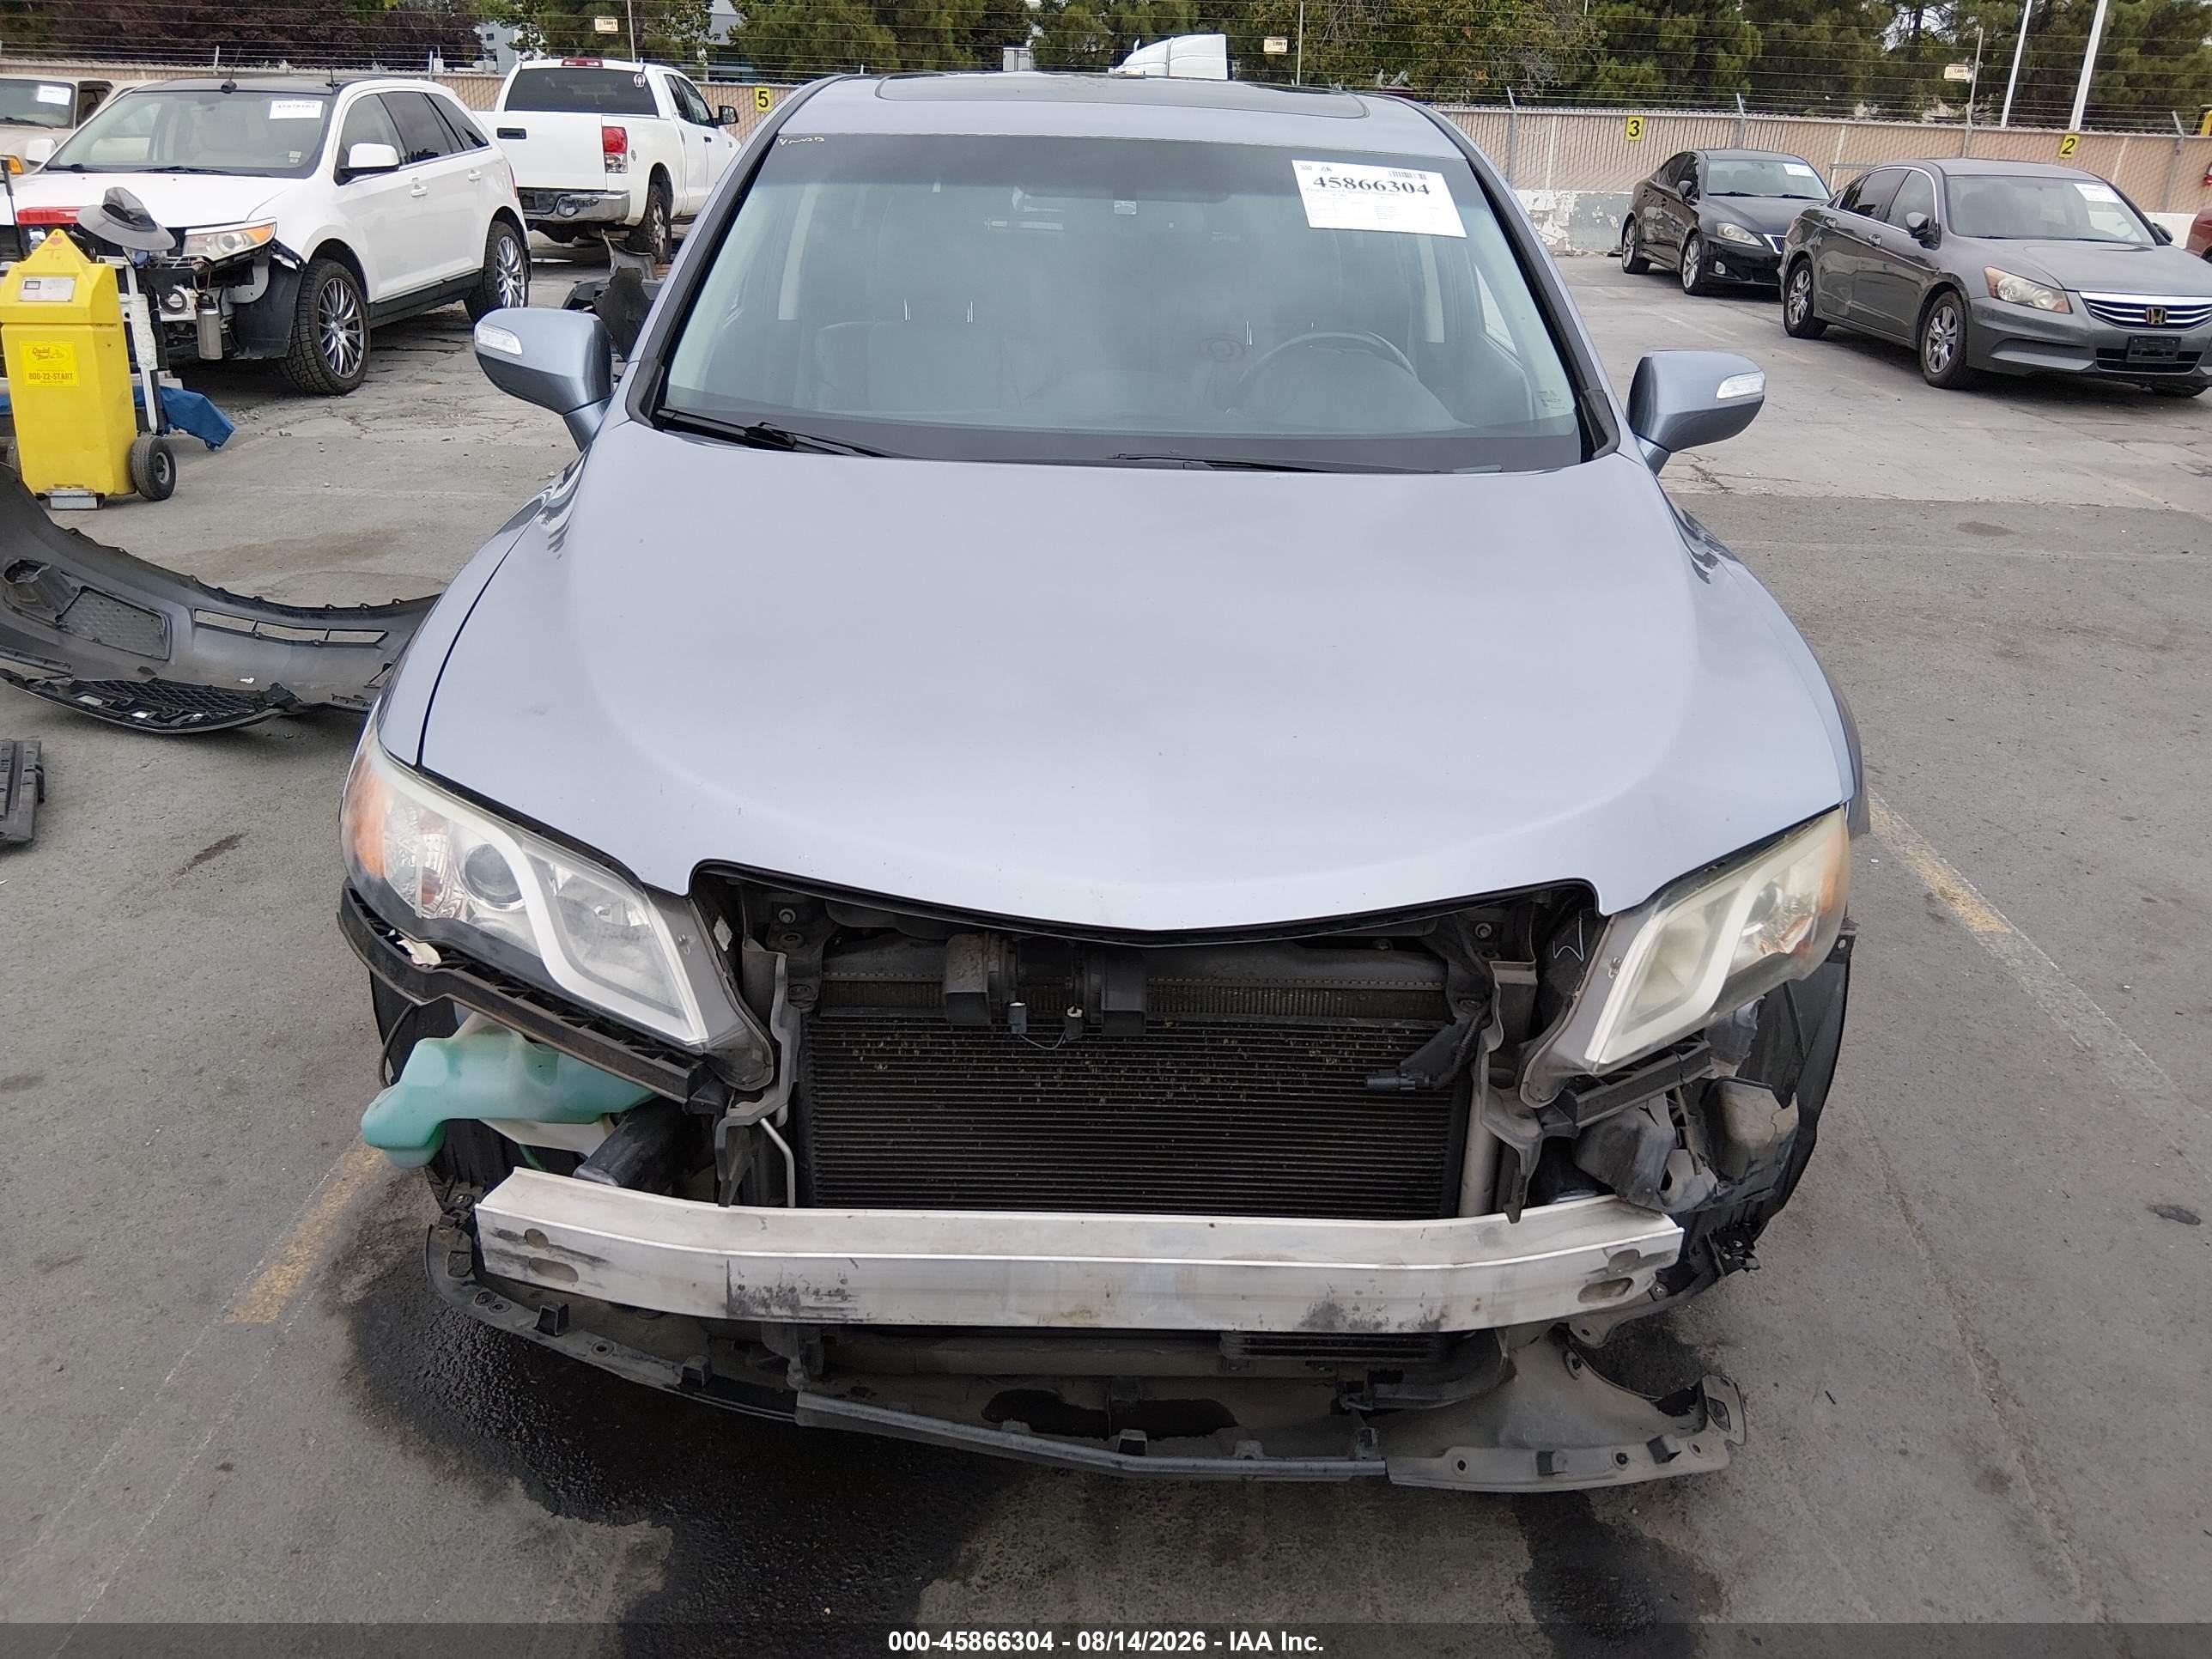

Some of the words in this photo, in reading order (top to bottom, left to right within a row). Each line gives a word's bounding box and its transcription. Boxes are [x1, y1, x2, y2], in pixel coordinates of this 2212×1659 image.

[757, 90, 769, 108] 5
[1628, 119, 1640, 137] 3
[2061, 137, 2076, 155] 2
[1313, 175, 1431, 196] 45866304
